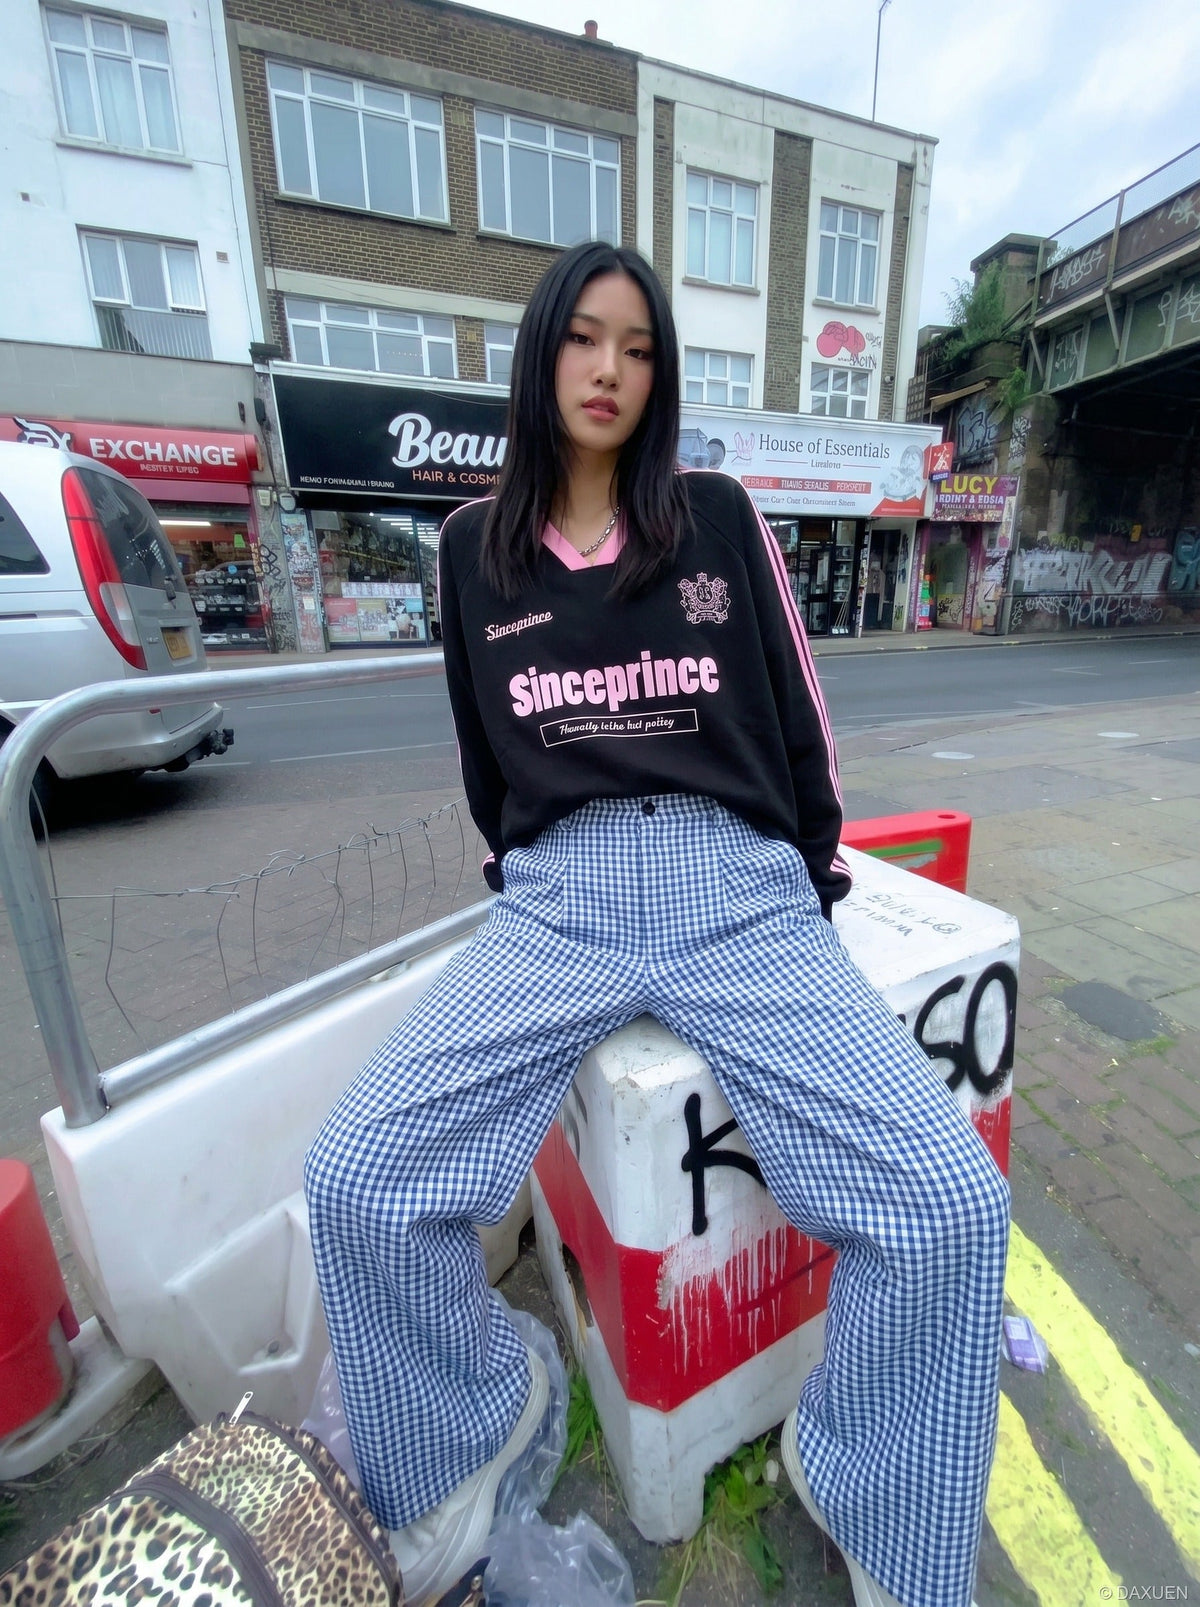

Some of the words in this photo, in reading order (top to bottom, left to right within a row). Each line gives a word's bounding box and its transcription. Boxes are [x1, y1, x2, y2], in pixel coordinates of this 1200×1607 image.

[89, 438, 238, 466] EXCHANGE
[388, 412, 509, 468] Beau
[759, 433, 803, 453] House
[807, 438, 822, 454] of
[825, 439, 890, 459] Essentials
[412, 470, 443, 482] HAIR
[447, 472, 457, 483] &
[940, 475, 999, 494] LUCY
